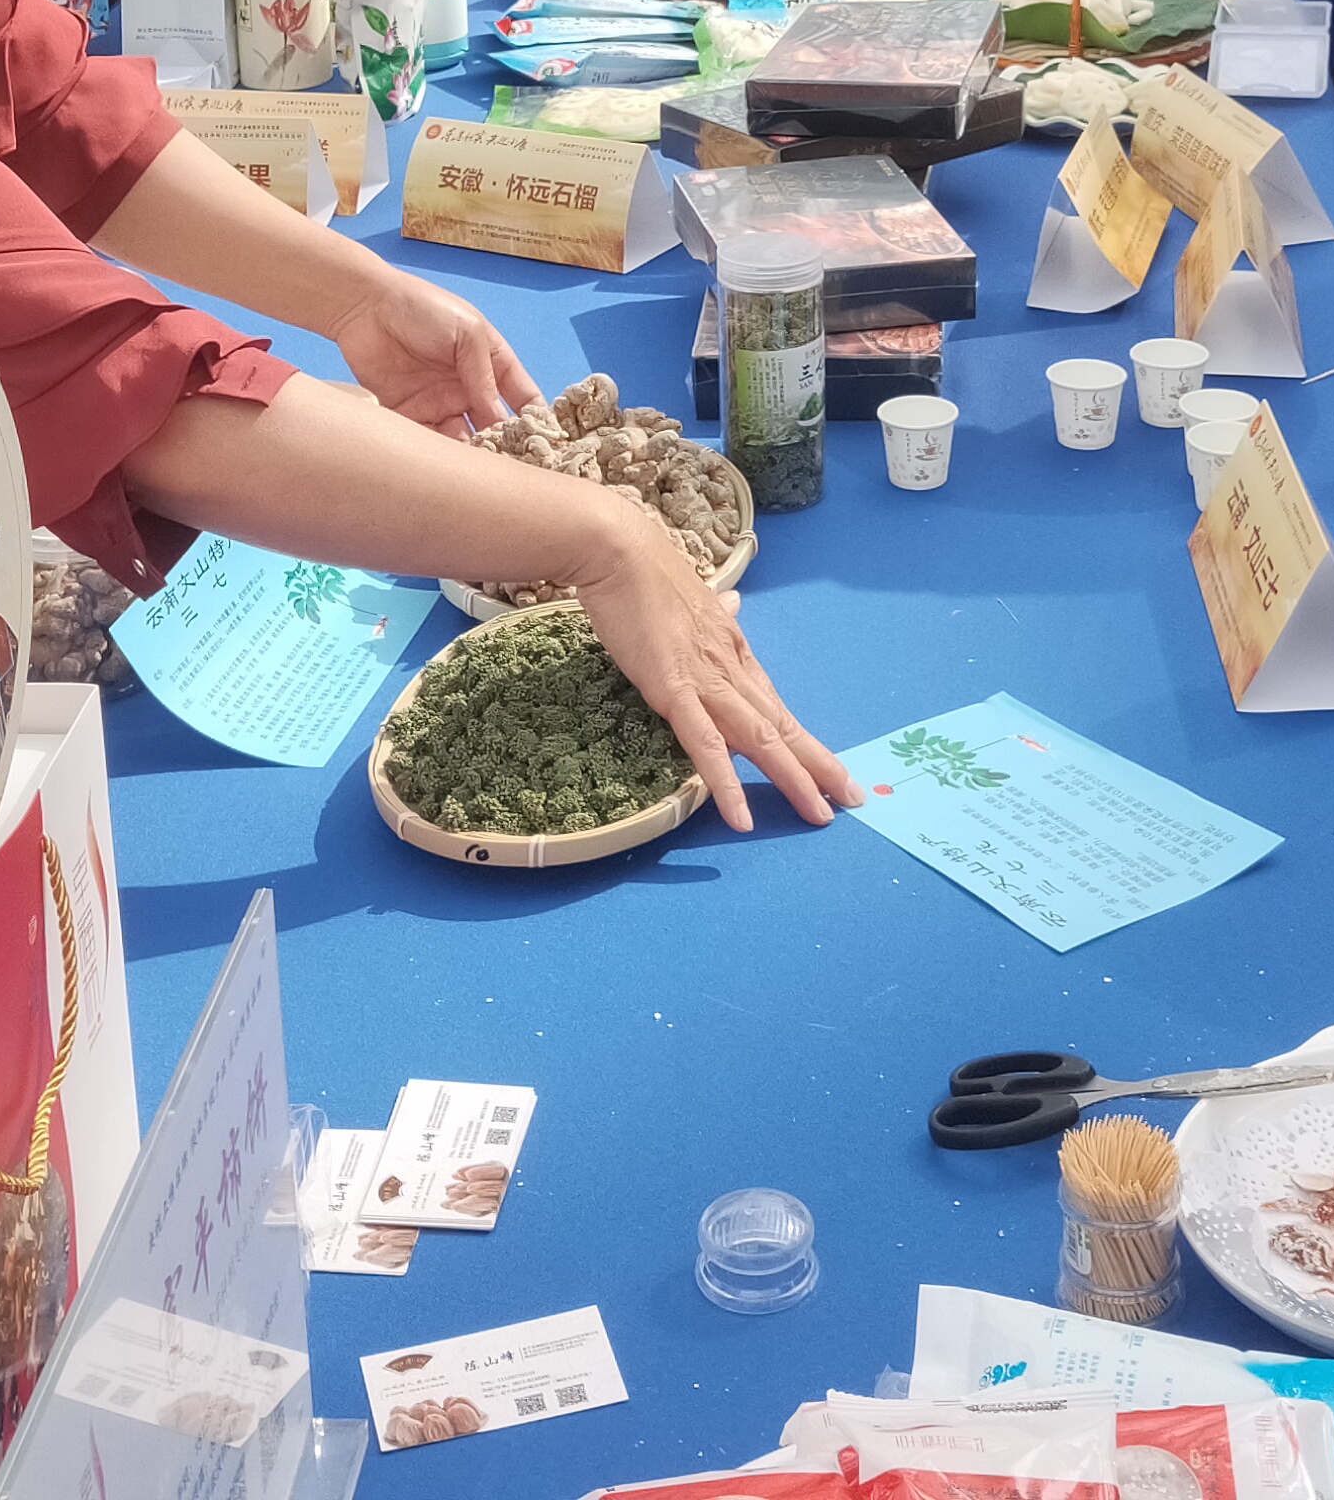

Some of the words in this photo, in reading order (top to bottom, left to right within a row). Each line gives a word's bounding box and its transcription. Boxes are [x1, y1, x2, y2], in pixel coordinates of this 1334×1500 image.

[916, 833, 1069, 929] 云南文山特产
[979, 838, 1065, 897] 三七花
[464, 1349, 518, 1373] 陈山峰
